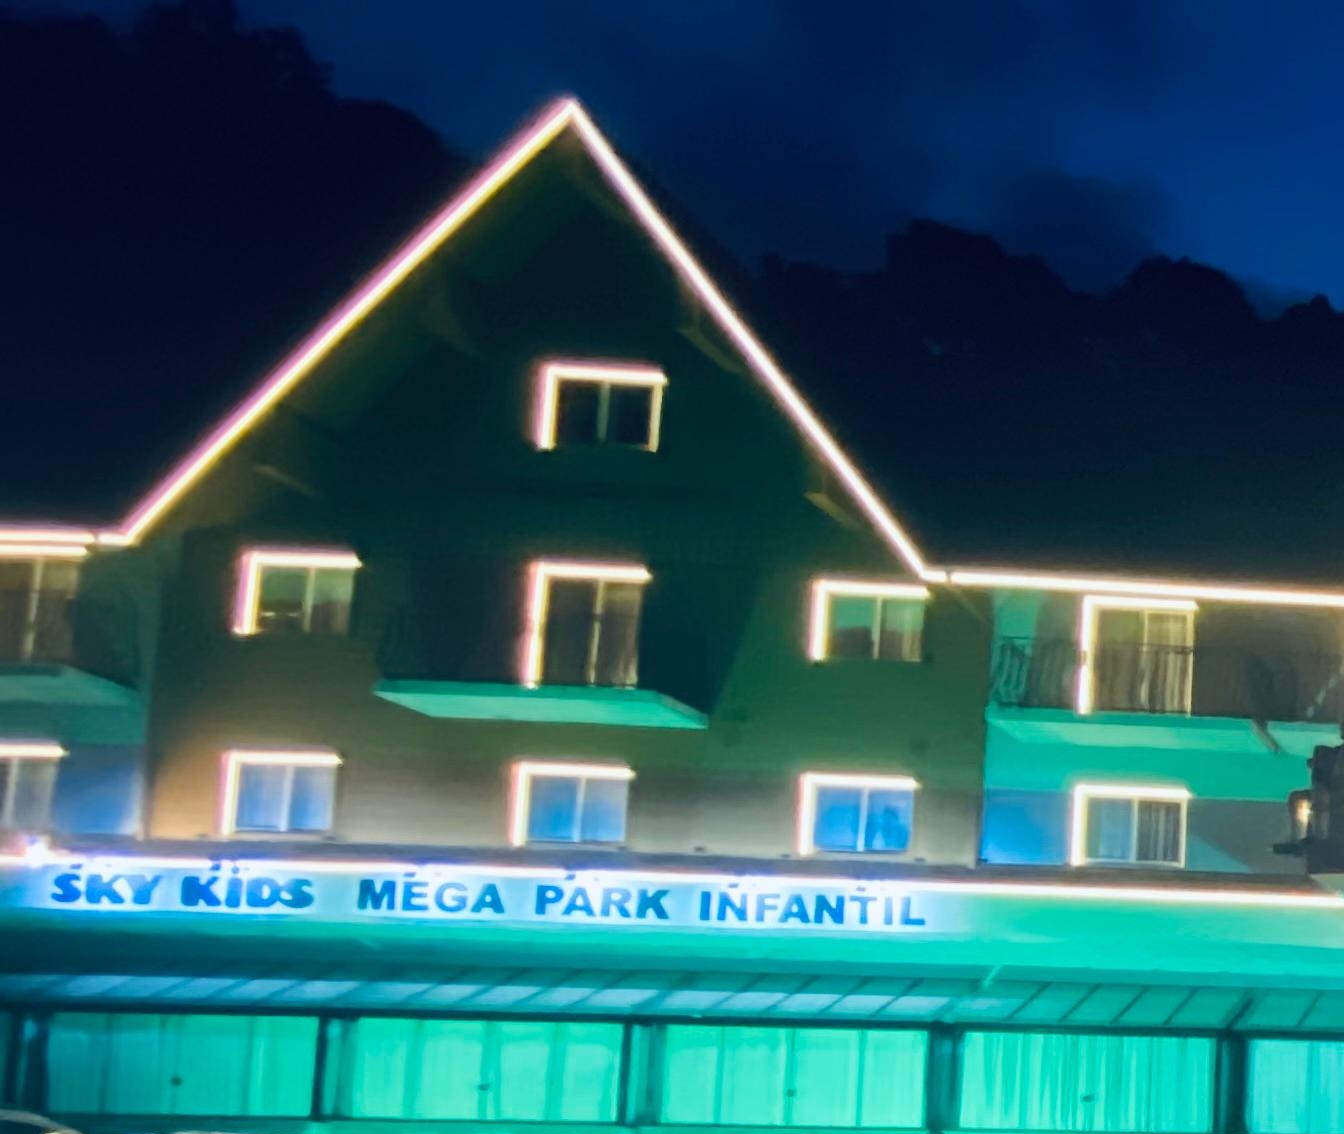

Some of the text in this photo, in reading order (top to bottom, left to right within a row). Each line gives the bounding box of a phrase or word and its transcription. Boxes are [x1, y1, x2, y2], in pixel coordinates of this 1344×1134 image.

[50, 872, 163, 905] SKY
[357, 878, 506, 915] MEGA
[534, 884, 671, 921] PARK
[699, 889, 927, 927] INFANTIL
